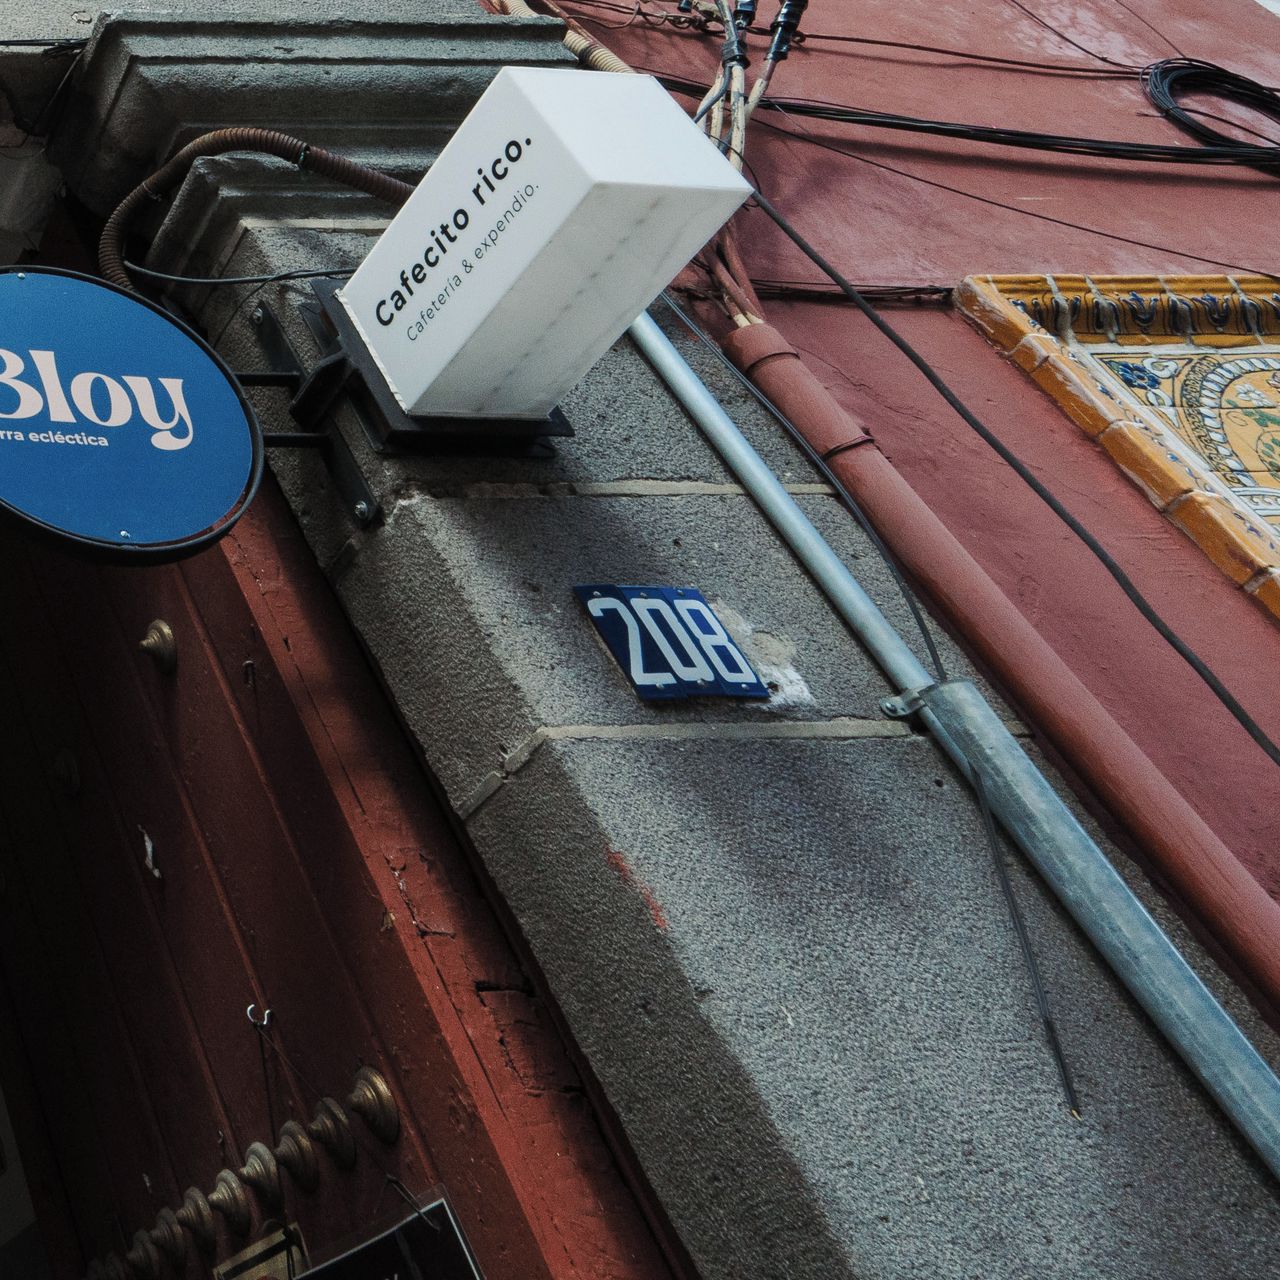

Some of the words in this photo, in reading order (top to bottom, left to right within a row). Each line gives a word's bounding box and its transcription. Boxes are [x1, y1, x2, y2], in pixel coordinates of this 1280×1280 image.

[375, 208, 470, 327] Cafecito
[471, 137, 532, 206] rico.
[406, 273, 463, 341] Cafetería
[461, 259, 475, 274] &
[474, 183, 540, 260] expendio.
[28, 430, 109, 447] ecléctica
[587, 597, 758, 686] 208
